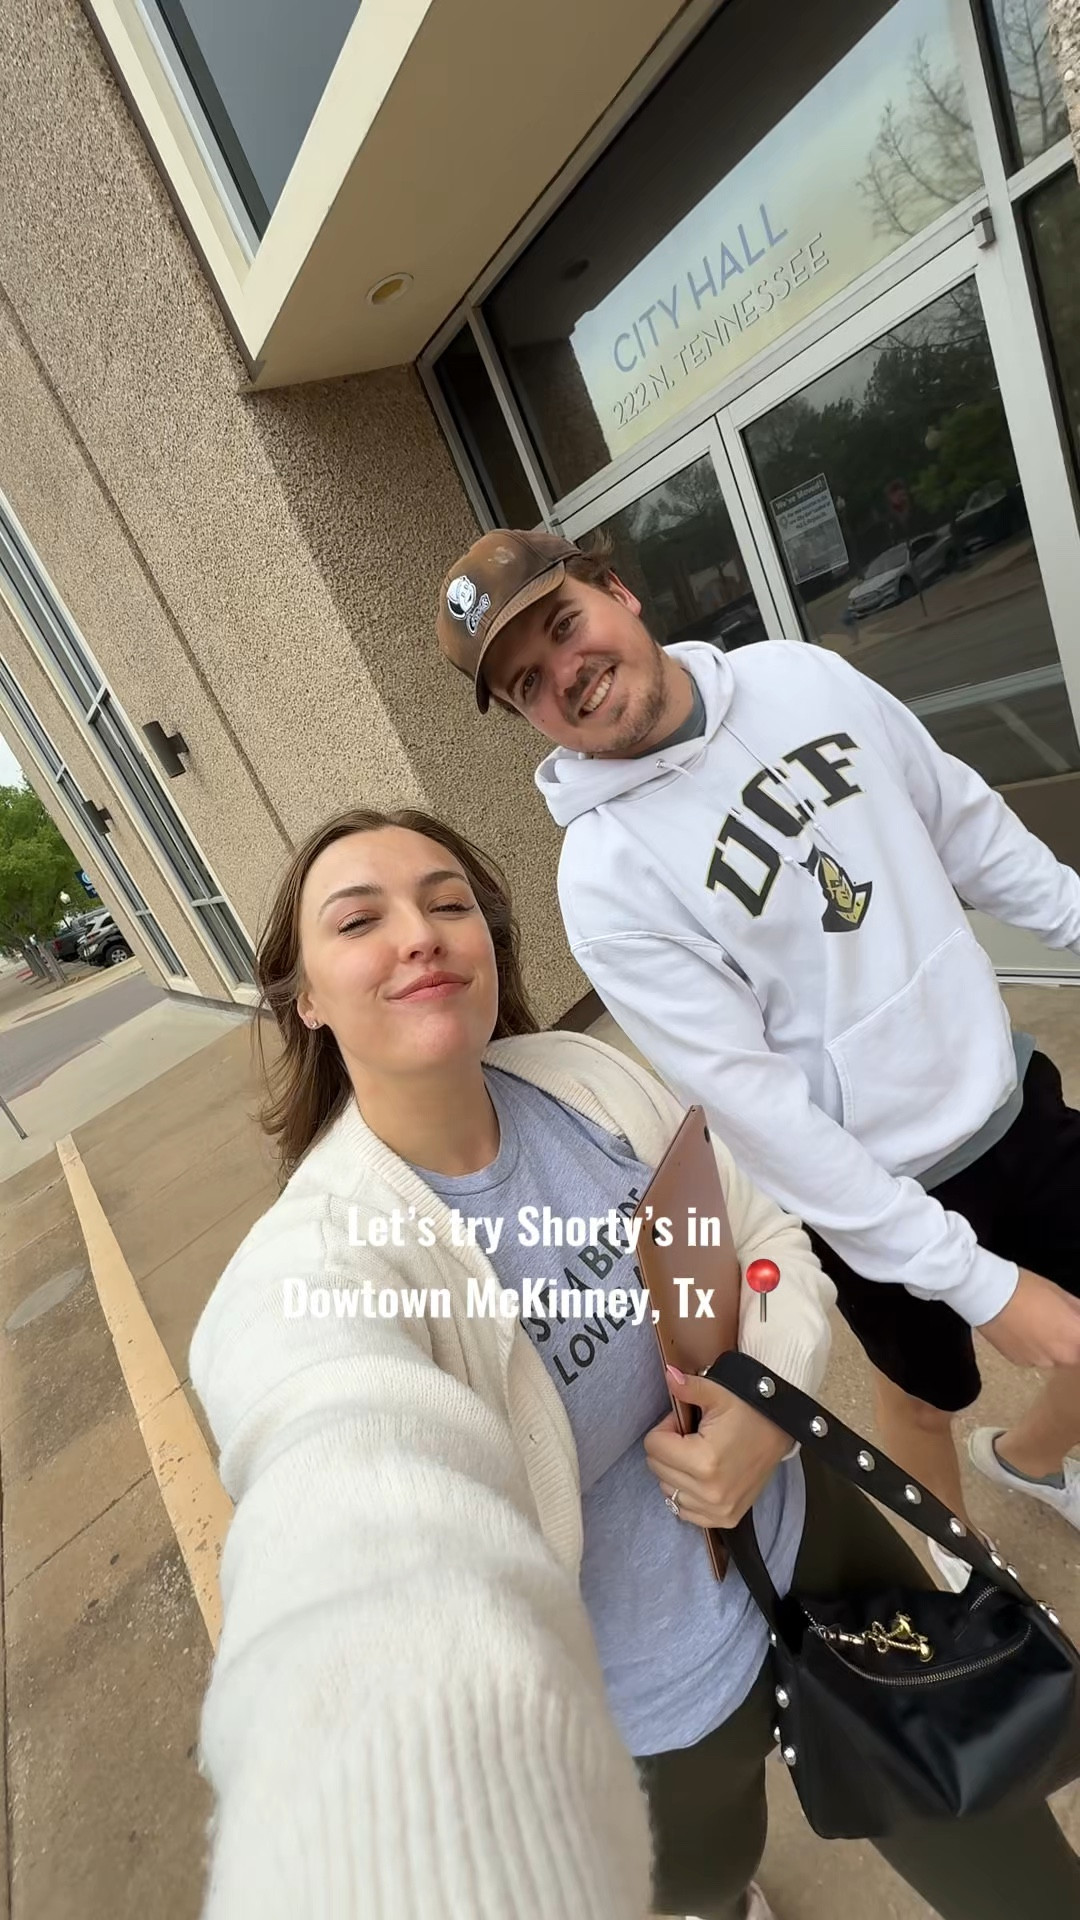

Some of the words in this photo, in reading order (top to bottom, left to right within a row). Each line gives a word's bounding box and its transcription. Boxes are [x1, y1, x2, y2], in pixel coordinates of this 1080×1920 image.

[613, 284, 680, 373] CITY
[687, 203, 788, 310] HALL
[613, 382, 652, 430] 222
[649, 365, 676, 399] N.
[674, 232, 830, 376] TENNESSEE
[704, 732, 866, 919] UCF
